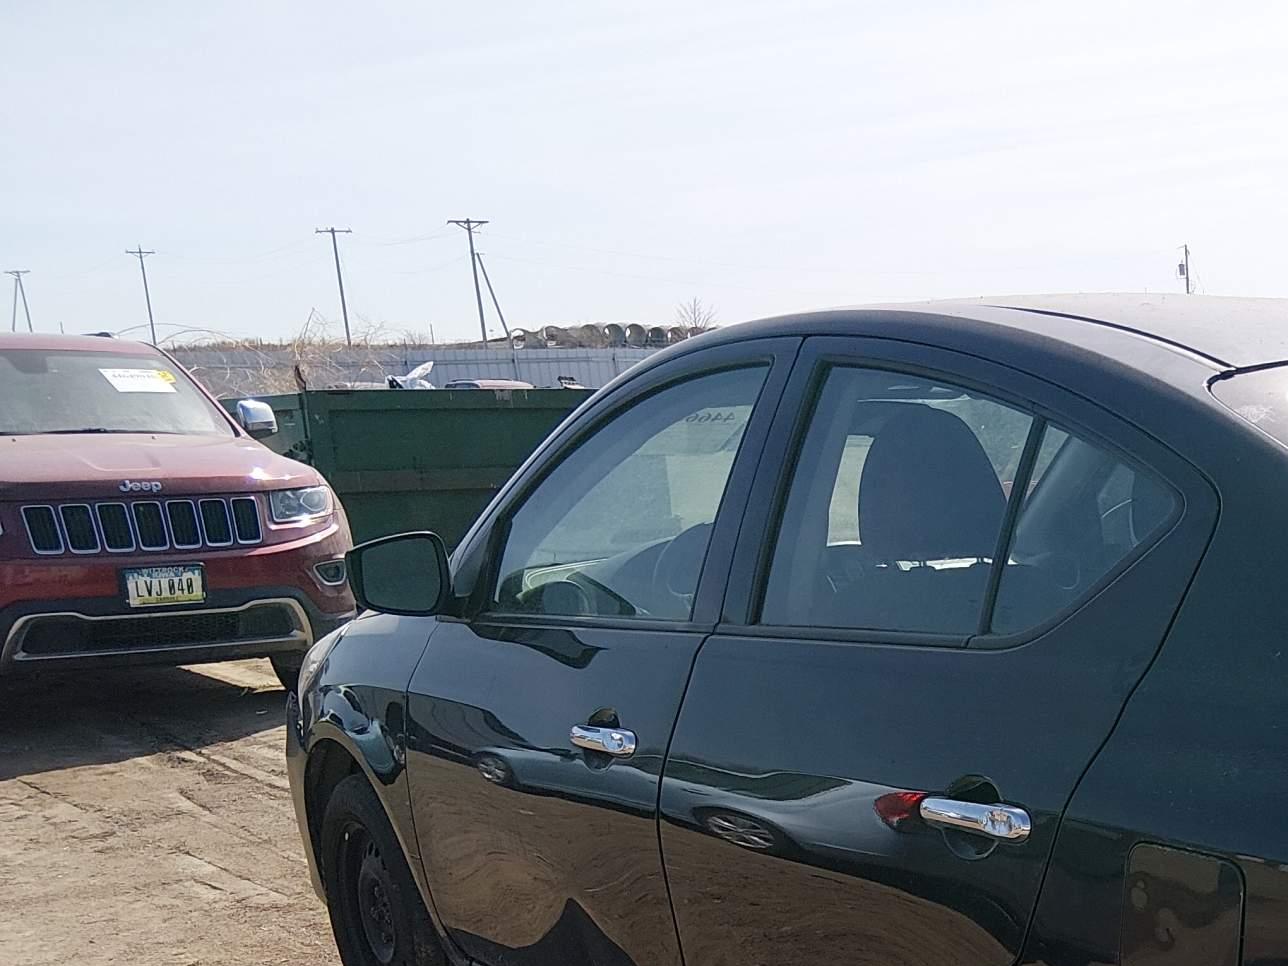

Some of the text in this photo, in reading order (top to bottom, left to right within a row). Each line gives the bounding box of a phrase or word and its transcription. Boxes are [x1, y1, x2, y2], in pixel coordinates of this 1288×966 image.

[119, 480, 162, 492] Jeep
[135, 577, 194, 597] LVJ 040
